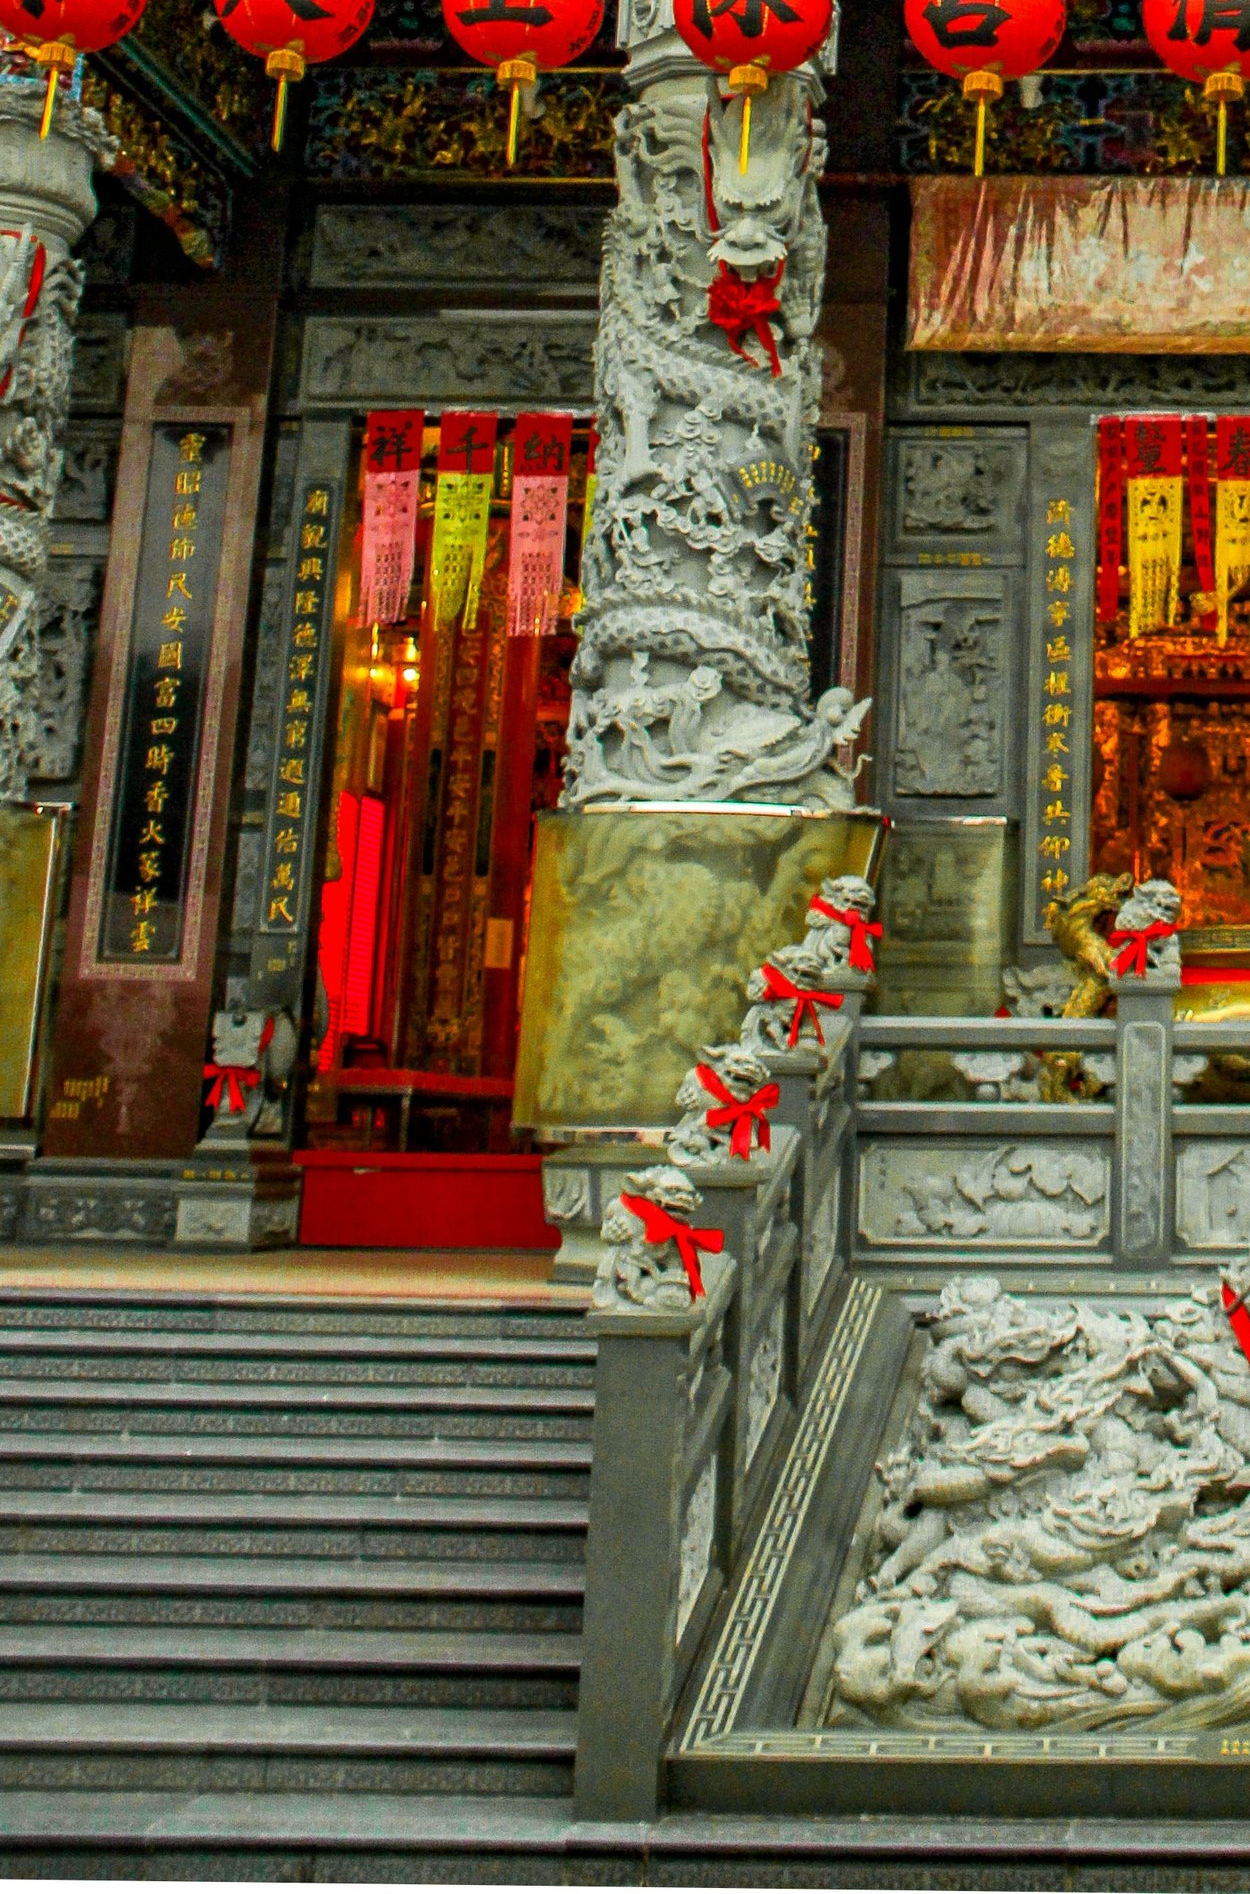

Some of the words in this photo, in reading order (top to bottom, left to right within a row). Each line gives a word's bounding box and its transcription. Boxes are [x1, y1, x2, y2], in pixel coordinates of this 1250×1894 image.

[370, 421, 414, 470] 祥
[446, 425, 490, 473] 千
[520, 432, 566, 473] 納
